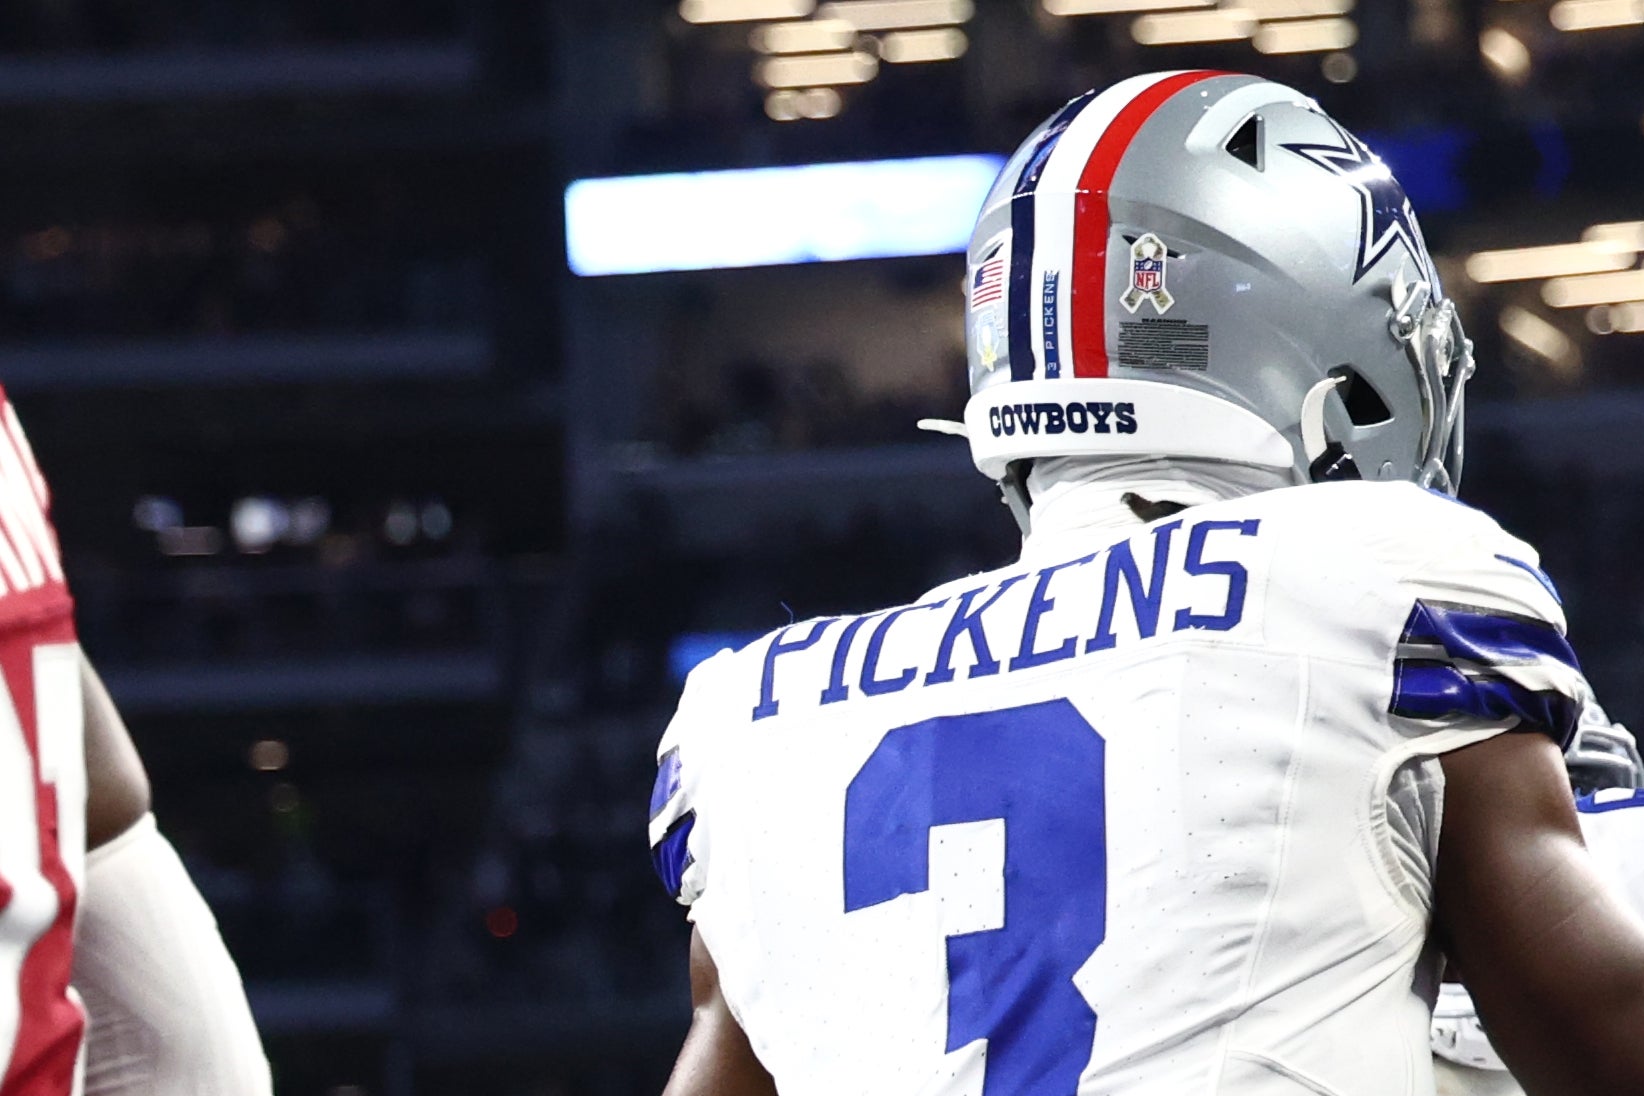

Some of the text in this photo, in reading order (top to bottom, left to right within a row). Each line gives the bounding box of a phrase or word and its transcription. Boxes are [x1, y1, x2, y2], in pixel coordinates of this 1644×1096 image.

[1136, 271, 1160, 289] NFL
[1044, 272, 1055, 350] PICKENS
[989, 402, 1138, 438] COWBOYS
[752, 518, 1261, 722] PICKENS
